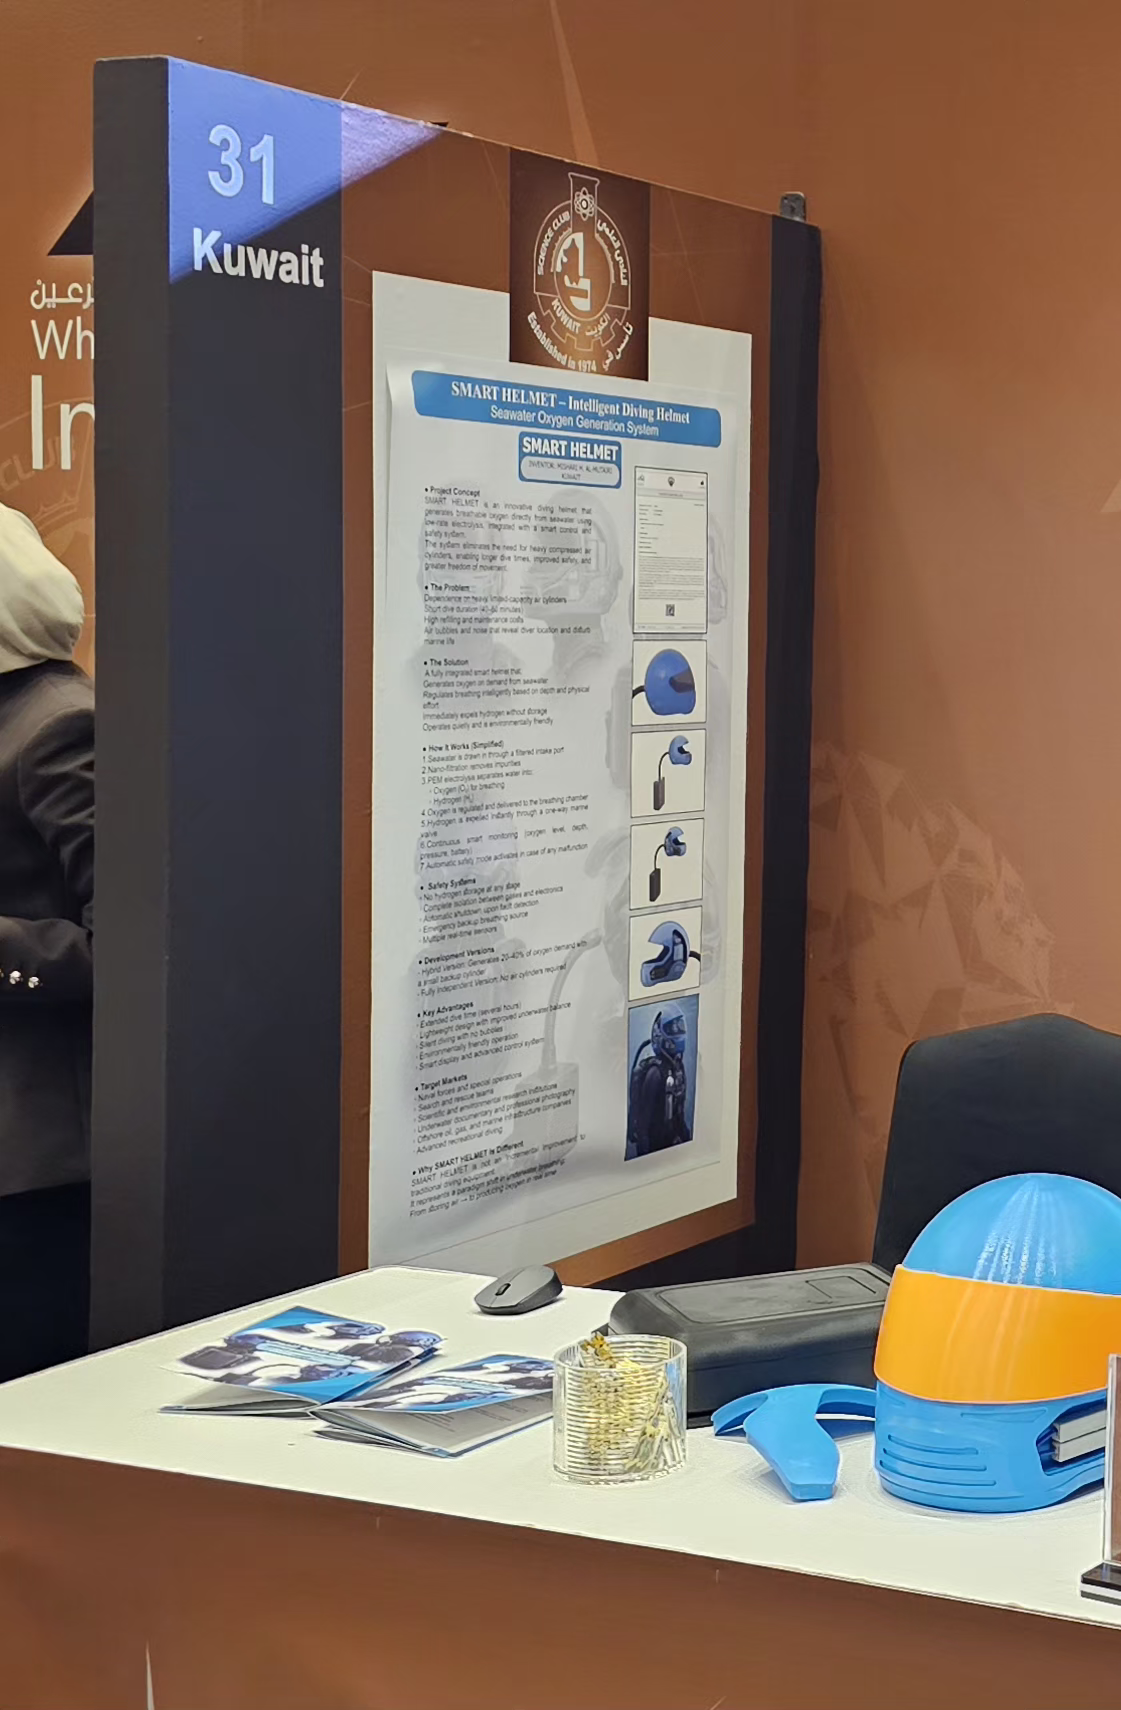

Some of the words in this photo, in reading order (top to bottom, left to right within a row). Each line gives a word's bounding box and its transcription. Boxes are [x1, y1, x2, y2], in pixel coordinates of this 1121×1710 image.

[207, 124, 274, 205] 31
[538, 226, 554, 276] SCIENCE
[553, 211, 571, 229] CLUB
[193, 227, 324, 288] Kuwait
[552, 298, 581, 334] KUWAIT
[527, 311, 567, 366] Established
[567, 356, 577, 370] in
[577, 360, 597, 373] 1974
[451, 381, 500, 400] SMART
[502, 387, 557, 408] HELMET
[568, 395, 620, 417] Intelligent
[622, 402, 654, 423] Diving
[657, 406, 690, 424] Helmet
[490, 405, 536, 423] Seawater
[537, 410, 573, 428] Oxygen
[575, 414, 625, 433] Generation
[627, 420, 659, 436] System
[522, 436, 567, 456] SMART
[570, 441, 619, 461] HELMET
[430, 486, 451, 496] Project
[453, 488, 480, 497] Concept
[431, 583, 442, 591] The
[430, 658, 442, 666] The
[444, 658, 469, 666] Solution
[428, 744, 443, 752] How
[471, 740, 504, 750] (Simplified)
[428, 881, 448, 890] Safety
[450, 878, 476, 888] Systems
[424, 952, 465, 965] Development
[467, 947, 495, 957] Versions
[422, 1008, 435, 1017] Key
[436, 1001, 473, 1015] Advantages
[421, 1080, 441, 1091] Target
[442, 1074, 468, 1085] Markets
[418, 1165, 433, 1175] Why
[435, 1157, 459, 1170] SMART
[460, 1150, 488, 1163] HELMET
[496, 1141, 524, 1153] Different
